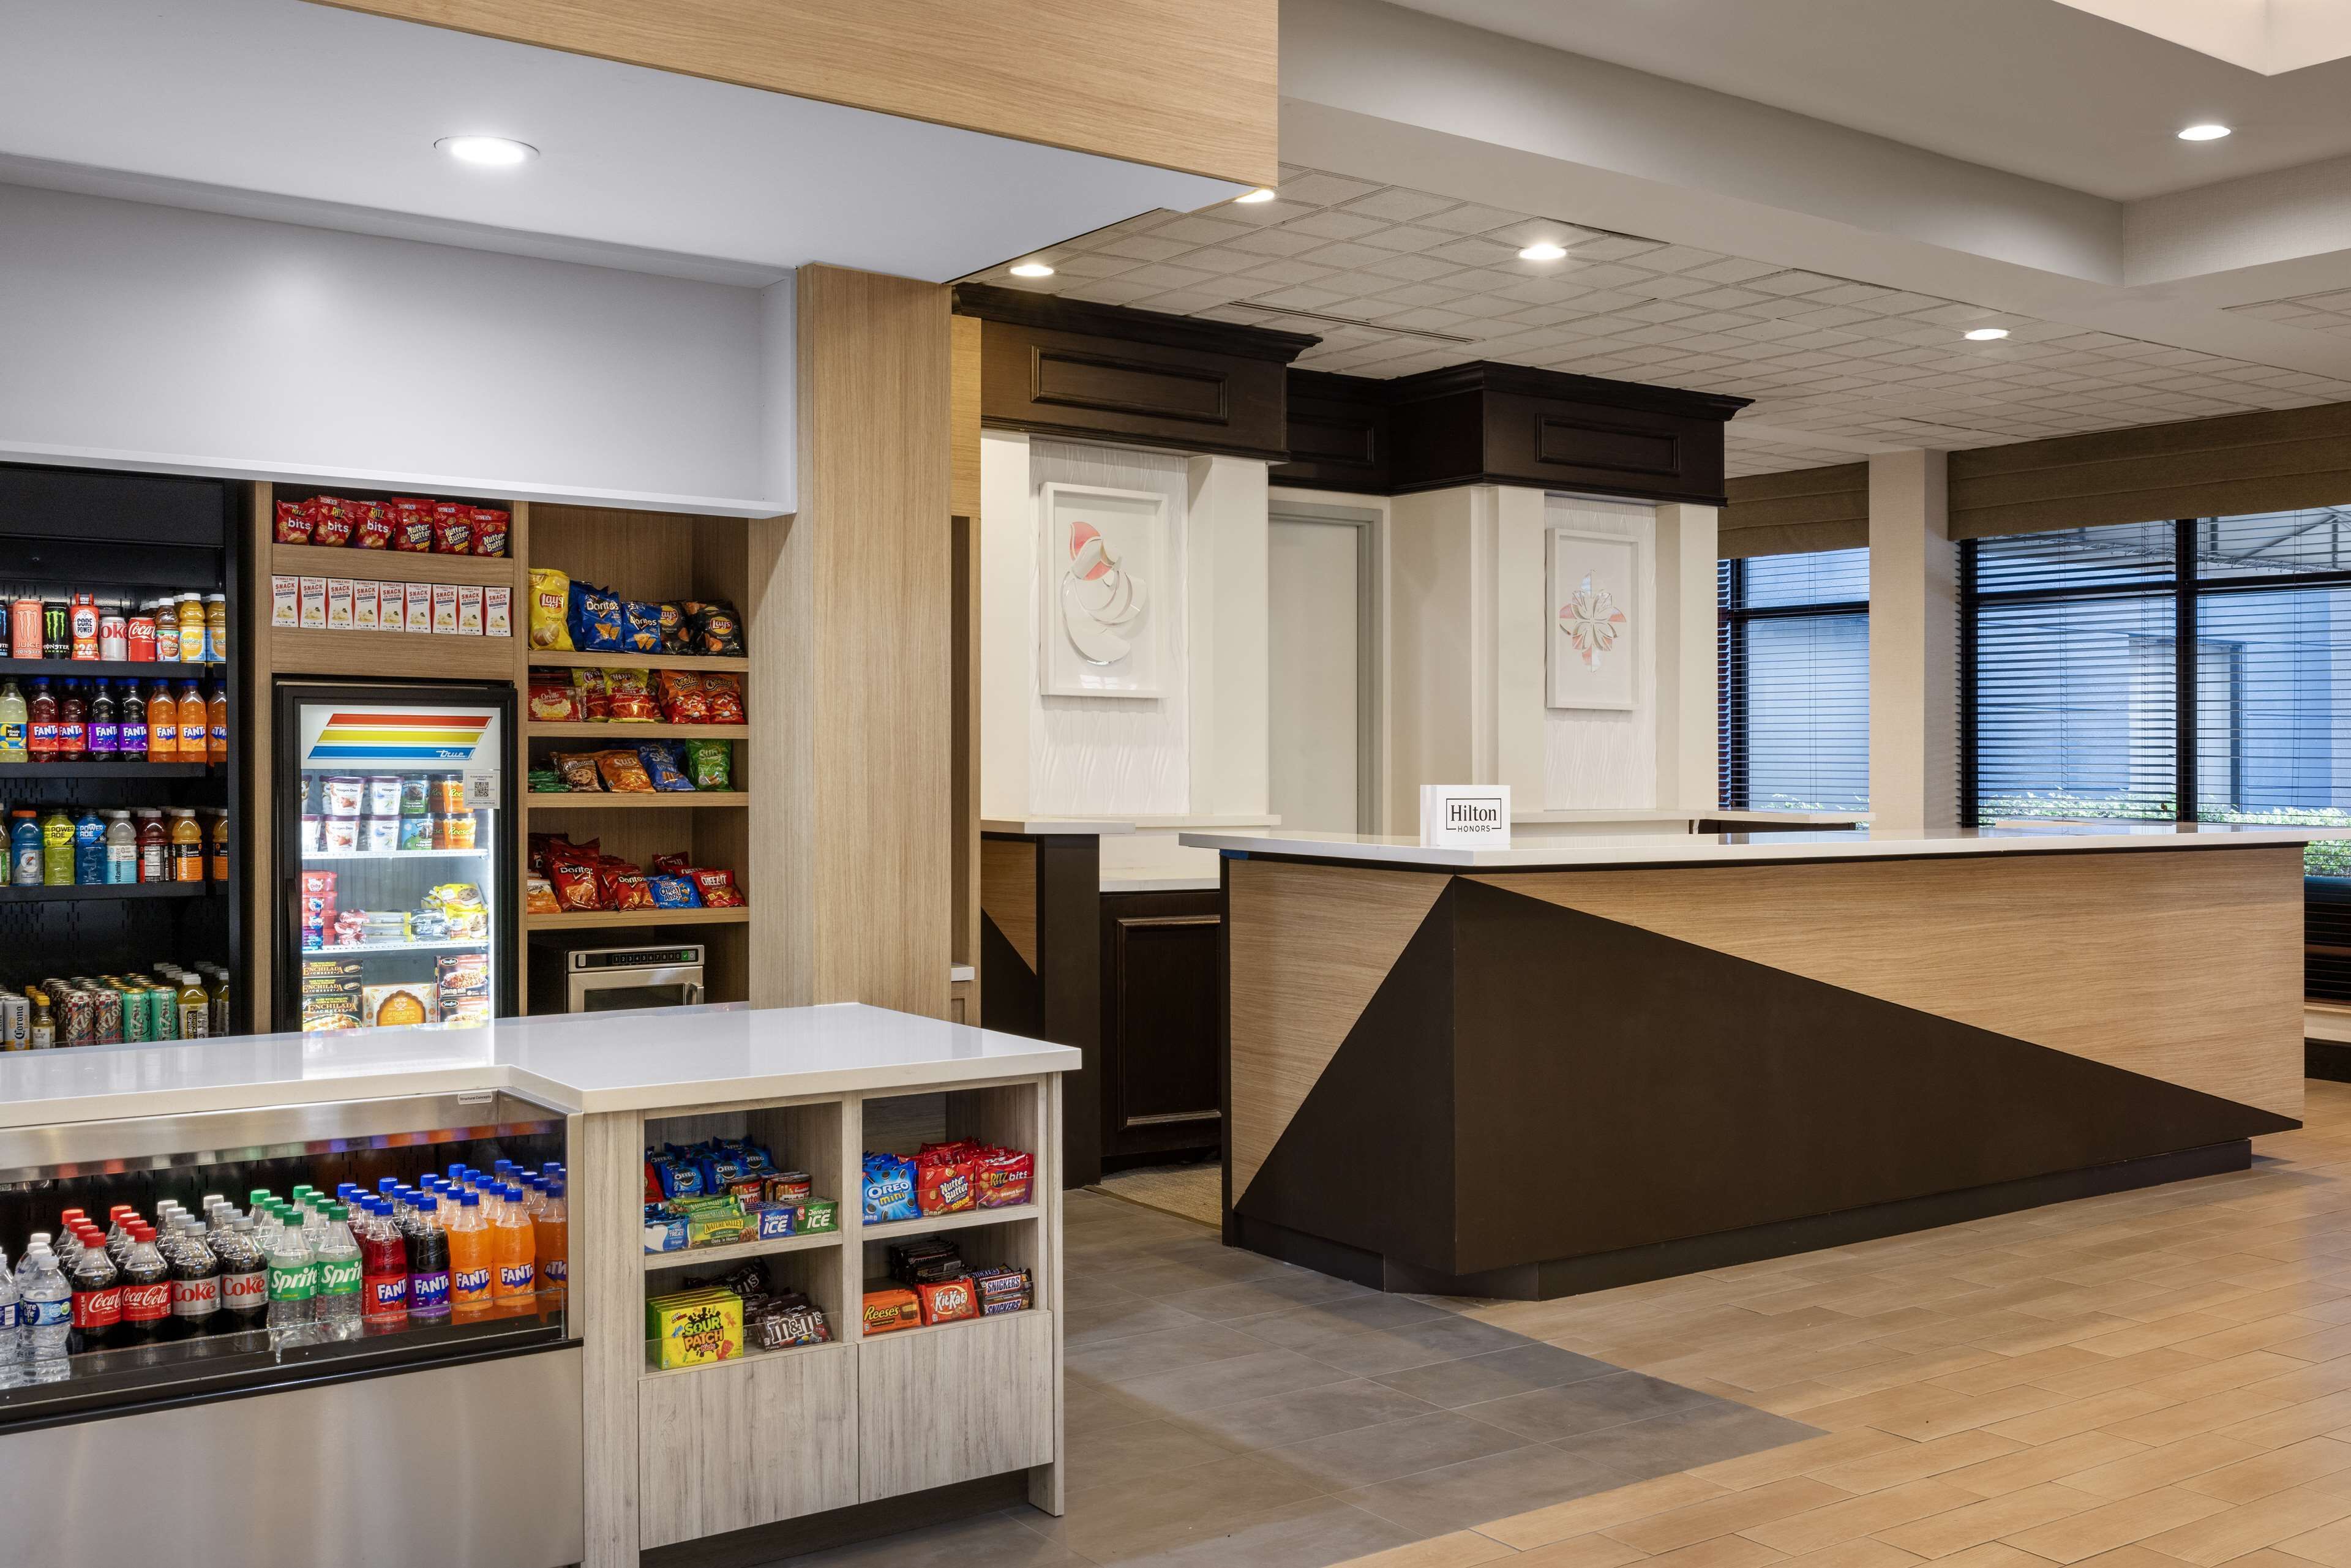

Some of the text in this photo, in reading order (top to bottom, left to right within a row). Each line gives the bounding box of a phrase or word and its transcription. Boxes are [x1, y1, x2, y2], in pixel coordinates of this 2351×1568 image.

[332, 507, 345, 517] RITZ
[372, 508, 384, 518] RITZ
[288, 517, 310, 530] bits
[328, 520, 349, 533] bits
[367, 520, 389, 533] bits
[407, 524, 429, 535] Nutter
[410, 530, 430, 542] Butter
[444, 525, 467, 536] Nutter
[449, 531, 469, 544] Butter
[483, 533, 504, 545] Nutter
[416, 541, 430, 550] Bites
[454, 541, 468, 552] Bites
[487, 539, 505, 552] Butter
[587, 601, 619, 611] Doritos
[77, 618, 92, 626] CORE
[661, 610, 677, 621] ay's
[34, 725, 58, 735] FANTA
[59, 725, 83, 735] FANTA
[156, 726, 176, 736] FANT
[1450, 805, 1497, 822] Hilton
[659, 886, 676, 897] Chips
[302, 966, 343, 975] ENCHILADA
[302, 985, 343, 993] ENCHILADA
[308, 1003, 358, 1013] ENCHILADA
[15, 1005, 25, 1040] Corona
[674, 1172, 696, 1180] OREO
[990, 1171, 1027, 1186] RITZ bits
[868, 1182, 909, 1198] OREO
[941, 1176, 965, 1195] Nutter
[879, 1193, 905, 1206] mini
[944, 1183, 969, 1203] Butter
[951, 1196, 969, 1210] Bites
[706, 1219, 744, 1231] NATURE VALLEY
[763, 1220, 788, 1234] ICE
[807, 1214, 830, 1229] ICE
[321, 1261, 362, 1288] Sprit
[456, 1269, 490, 1288] FANTA
[500, 1264, 534, 1283] FANTA
[222, 1276, 265, 1296] Coke
[271, 1267, 317, 1294] Sprite
[414, 1275, 449, 1294] FANTA
[987, 1276, 1020, 1293] SNICKERS
[122, 1283, 168, 1306] Coca-Cola
[174, 1283, 216, 1302] Coke
[23, 1300, 37, 1311] Pure
[987, 1300, 1020, 1315] SNICKERS
[864, 1305, 899, 1321] Reese's
[684, 1316, 721, 1336] SOUR
[684, 1330, 724, 1351] PATCH
